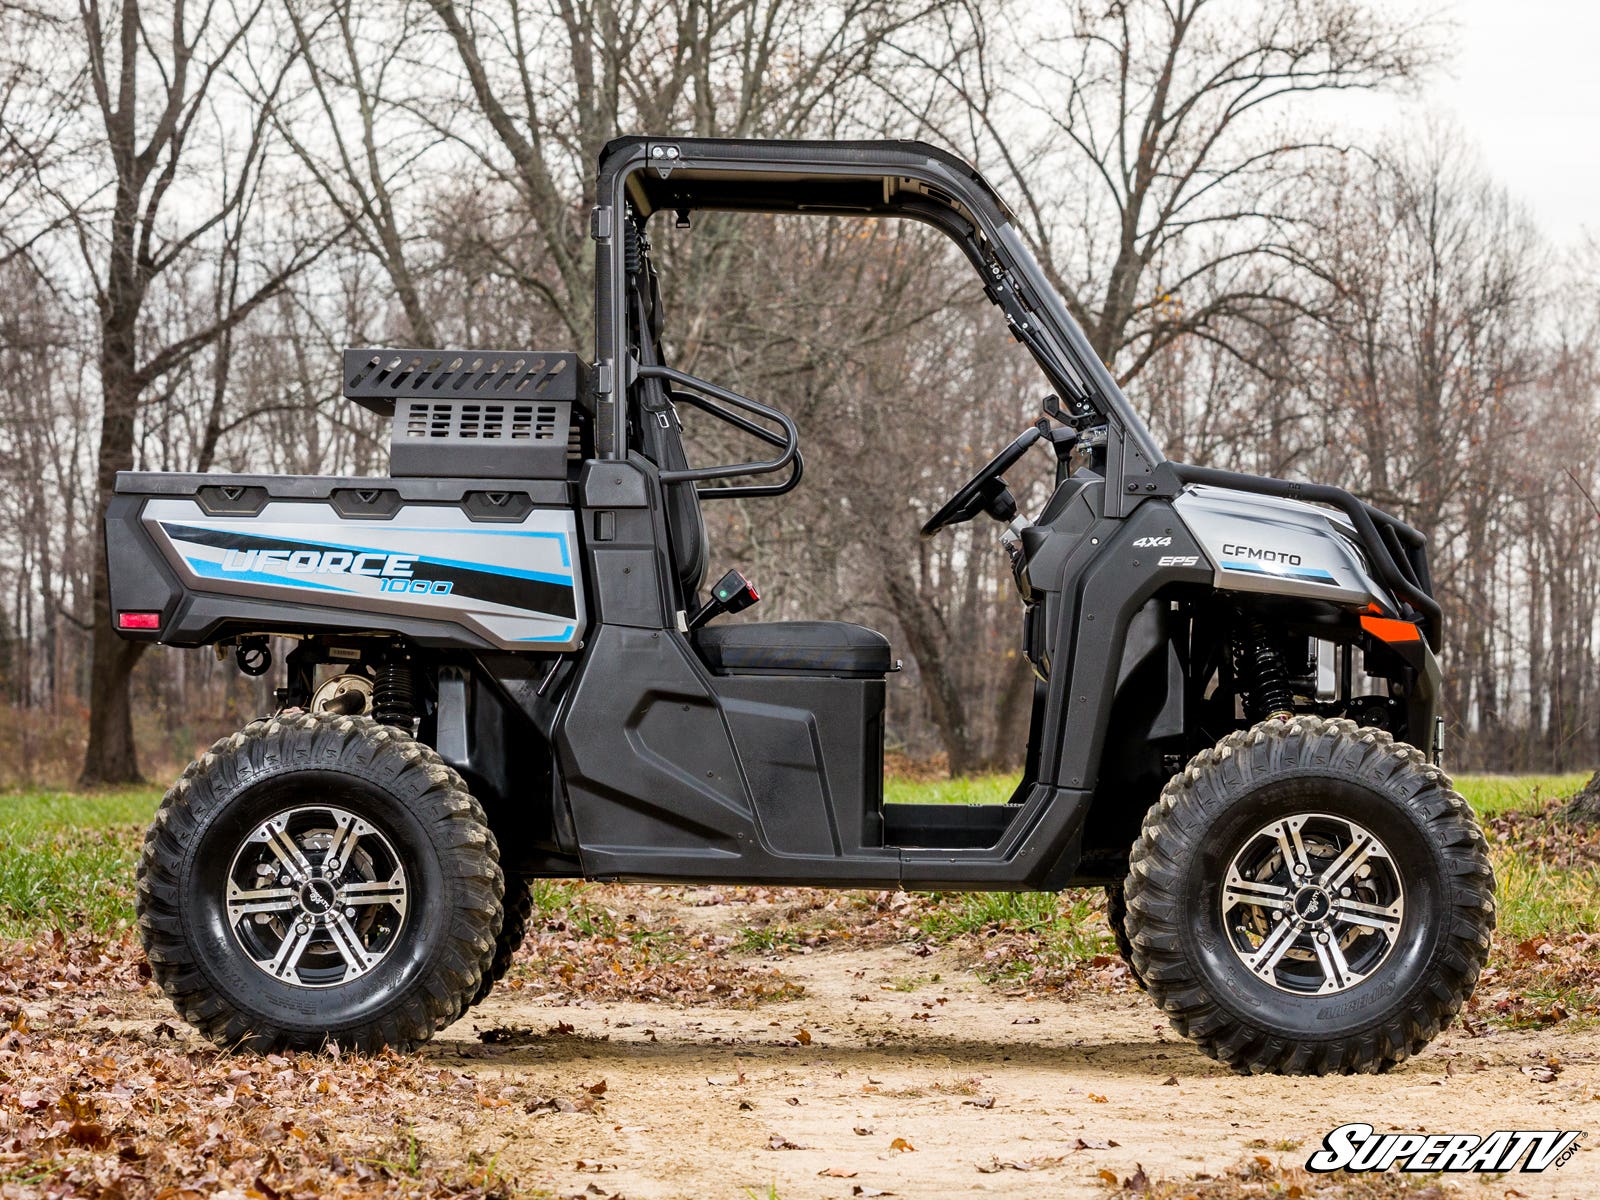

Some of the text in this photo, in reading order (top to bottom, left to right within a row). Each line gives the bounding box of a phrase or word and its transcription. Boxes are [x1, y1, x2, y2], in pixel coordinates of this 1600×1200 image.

[1133, 537, 1171, 547] 4X4
[222, 549, 419, 577] UFORCE
[1158, 557, 1199, 566] EPS
[1222, 544, 1301, 566] CFMOTO
[379, 578, 454, 595] 1000
